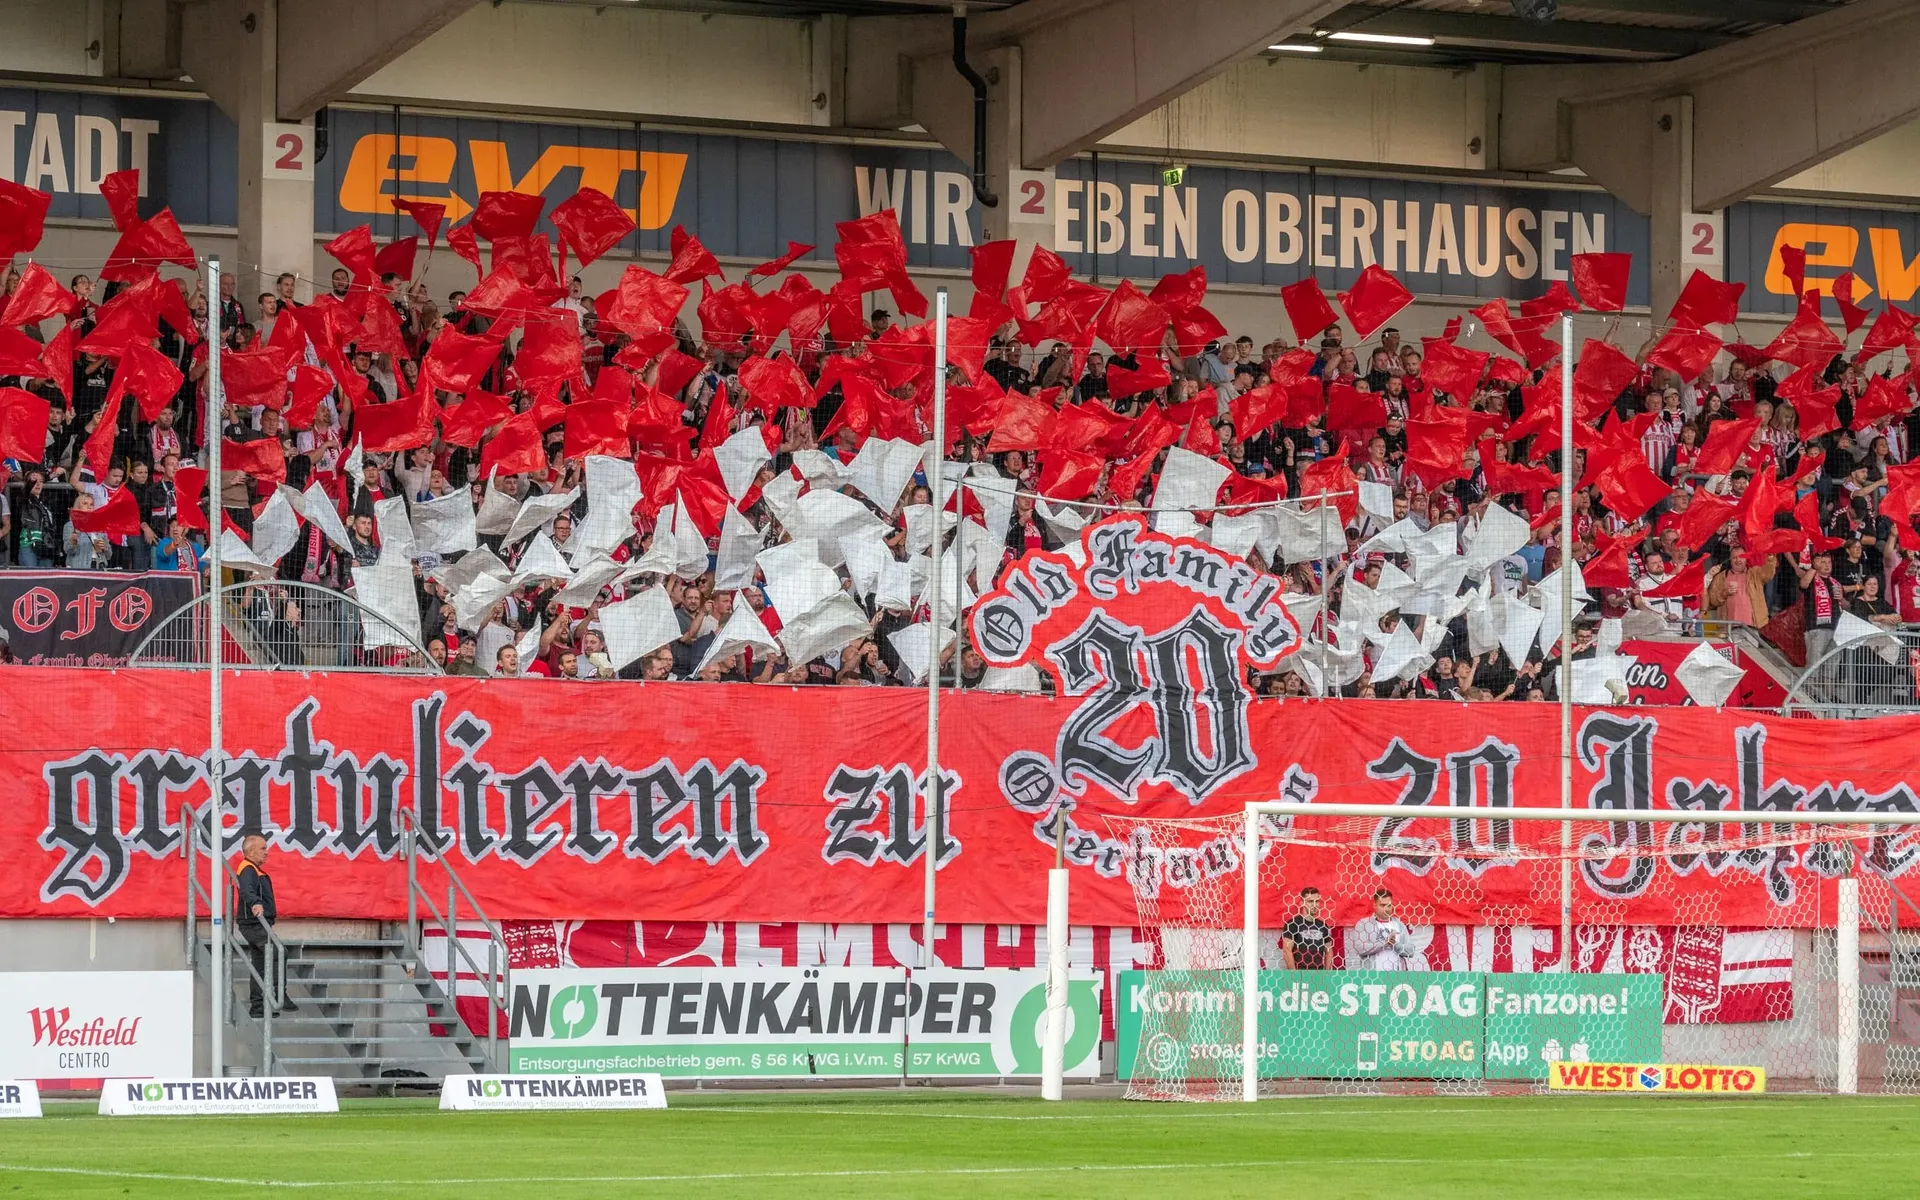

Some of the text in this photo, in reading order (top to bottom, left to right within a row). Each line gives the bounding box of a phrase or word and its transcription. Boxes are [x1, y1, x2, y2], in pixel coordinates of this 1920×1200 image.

[275, 133, 304, 170] 2
[1020, 180, 1046, 215] 2
[854, 166, 1605, 282] WIR EBEN OBERHAUSEN
[1691, 222, 1714, 256] 2
[979, 526, 1295, 660] Old Family
[12, 586, 153, 641] OFO
[1051, 606, 1252, 799] 20
[43, 695, 766, 903] gratulieren
[825, 764, 960, 865] zu
[1368, 738, 1518, 873] 20
[510, 969, 997, 1039] NOTTENKÄMPER
[1130, 984, 1236, 1013] Komm
[1279, 983, 1330, 1013] die
[1339, 983, 1477, 1017] STOAG
[1487, 986, 1629, 1015] Fanzone!
[27, 1006, 142, 1047] Westfield
[59, 1052, 110, 1069] CENTRO
[518, 1054, 701, 1074] Entsorgungsfachbetrieb
[705, 1055, 746, 1070] gem.
[751, 1053, 761, 1069] §
[766, 1053, 788, 1066] 56
[844, 1053, 890, 1066] i.V.m.
[893, 1053, 904, 1069] §
[912, 1051, 933, 1066] 57
[936, 1051, 981, 1066] KrWG
[1190, 1037, 1280, 1064] stoagde
[1389, 1040, 1529, 1066] STOAG App
[127, 1078, 318, 1102] NOTTENKÄMPER
[467, 1075, 647, 1097] NOTTENKÄMPER
[1558, 1064, 1756, 1092] WEST LOTTO
